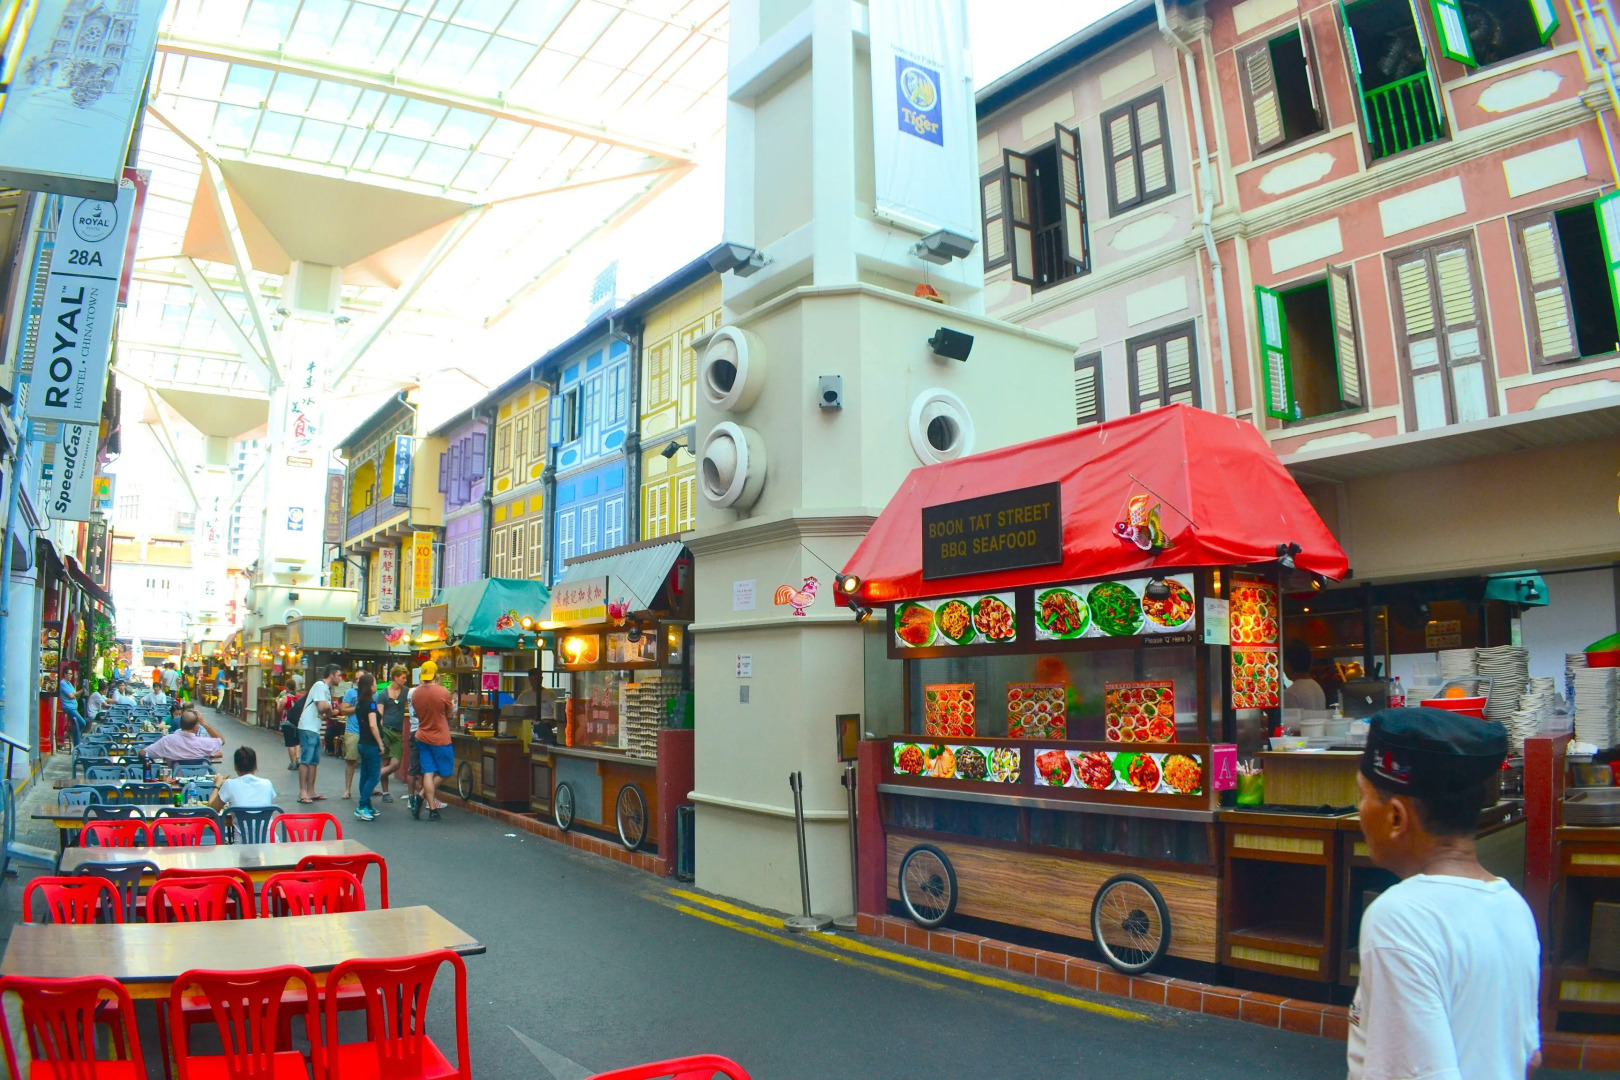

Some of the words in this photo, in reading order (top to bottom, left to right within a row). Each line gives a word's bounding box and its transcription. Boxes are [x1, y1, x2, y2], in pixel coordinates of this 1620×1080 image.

[901, 107, 939, 134] Tiger
[79, 217, 109, 227] ROYAL
[68, 248, 103, 267] 28A
[45, 286, 85, 408] ROYAL
[73, 367, 87, 409] HOSTEL
[81, 287, 99, 357] CHINATOWN
[55, 424, 82, 513] SpeedCas
[929, 518, 963, 539] BOON
[969, 513, 992, 532] TAT
[997, 502, 1051, 528] STREET
[416, 546, 430, 557] XO
[941, 540, 967, 559] BBQ
[973, 529, 1037, 555] SEAFOOD
[1144, 636, 1163, 644] Please
[486, 676, 495, 687] A
[1218, 756, 1232, 780] A
